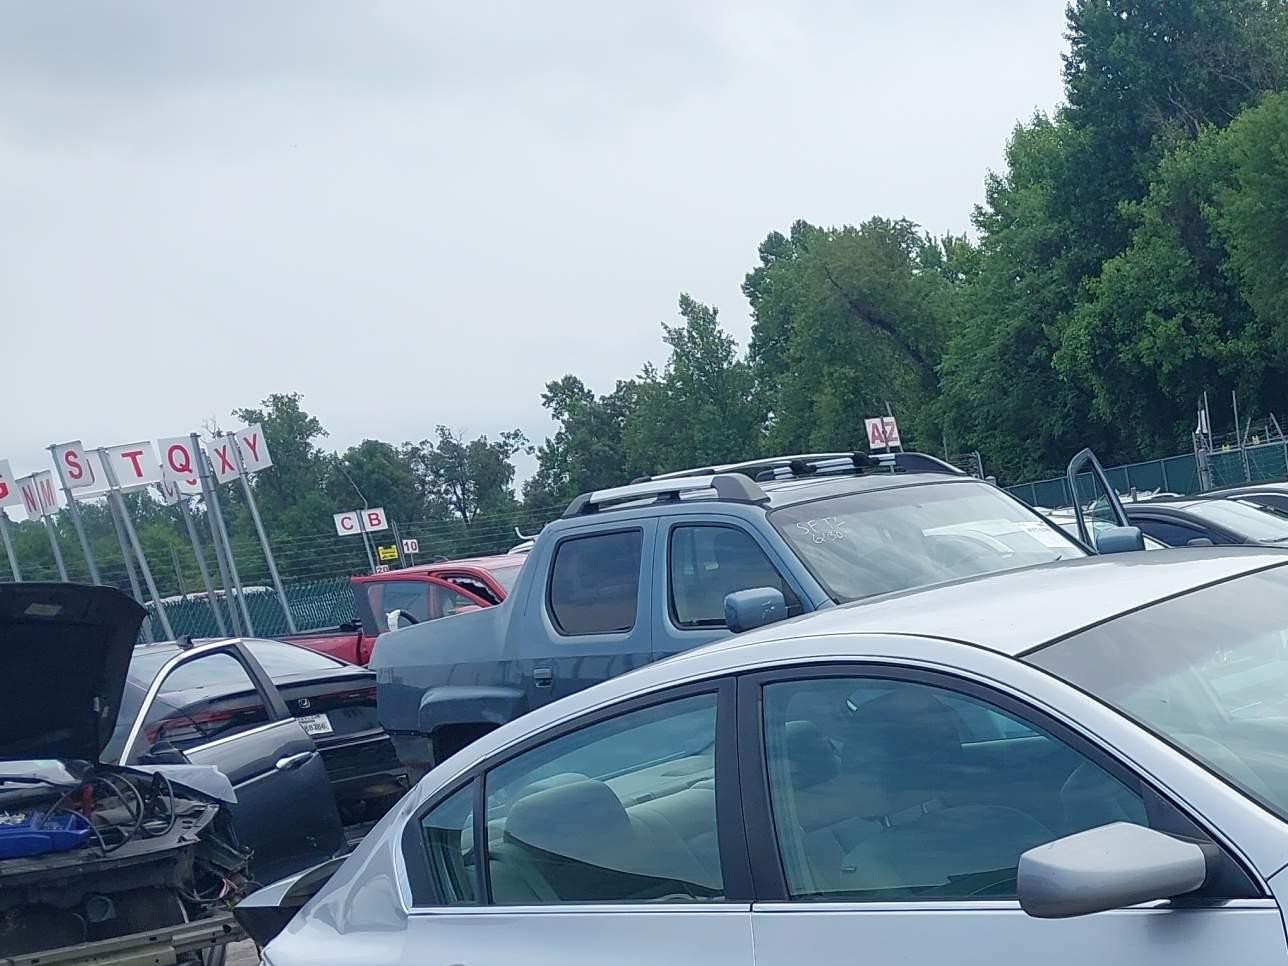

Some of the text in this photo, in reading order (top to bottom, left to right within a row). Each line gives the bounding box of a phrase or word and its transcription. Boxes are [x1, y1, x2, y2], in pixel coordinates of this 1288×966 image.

[167, 445, 193, 474] Q
[214, 445, 235, 475] X
[243, 433, 259, 462] Y
[64, 450, 83, 480] S
[121, 450, 144, 478] T
[22, 484, 37, 513] N
[341, 517, 354, 530] C
[368, 512, 381, 527] B
[404, 541, 417, 552] 10
